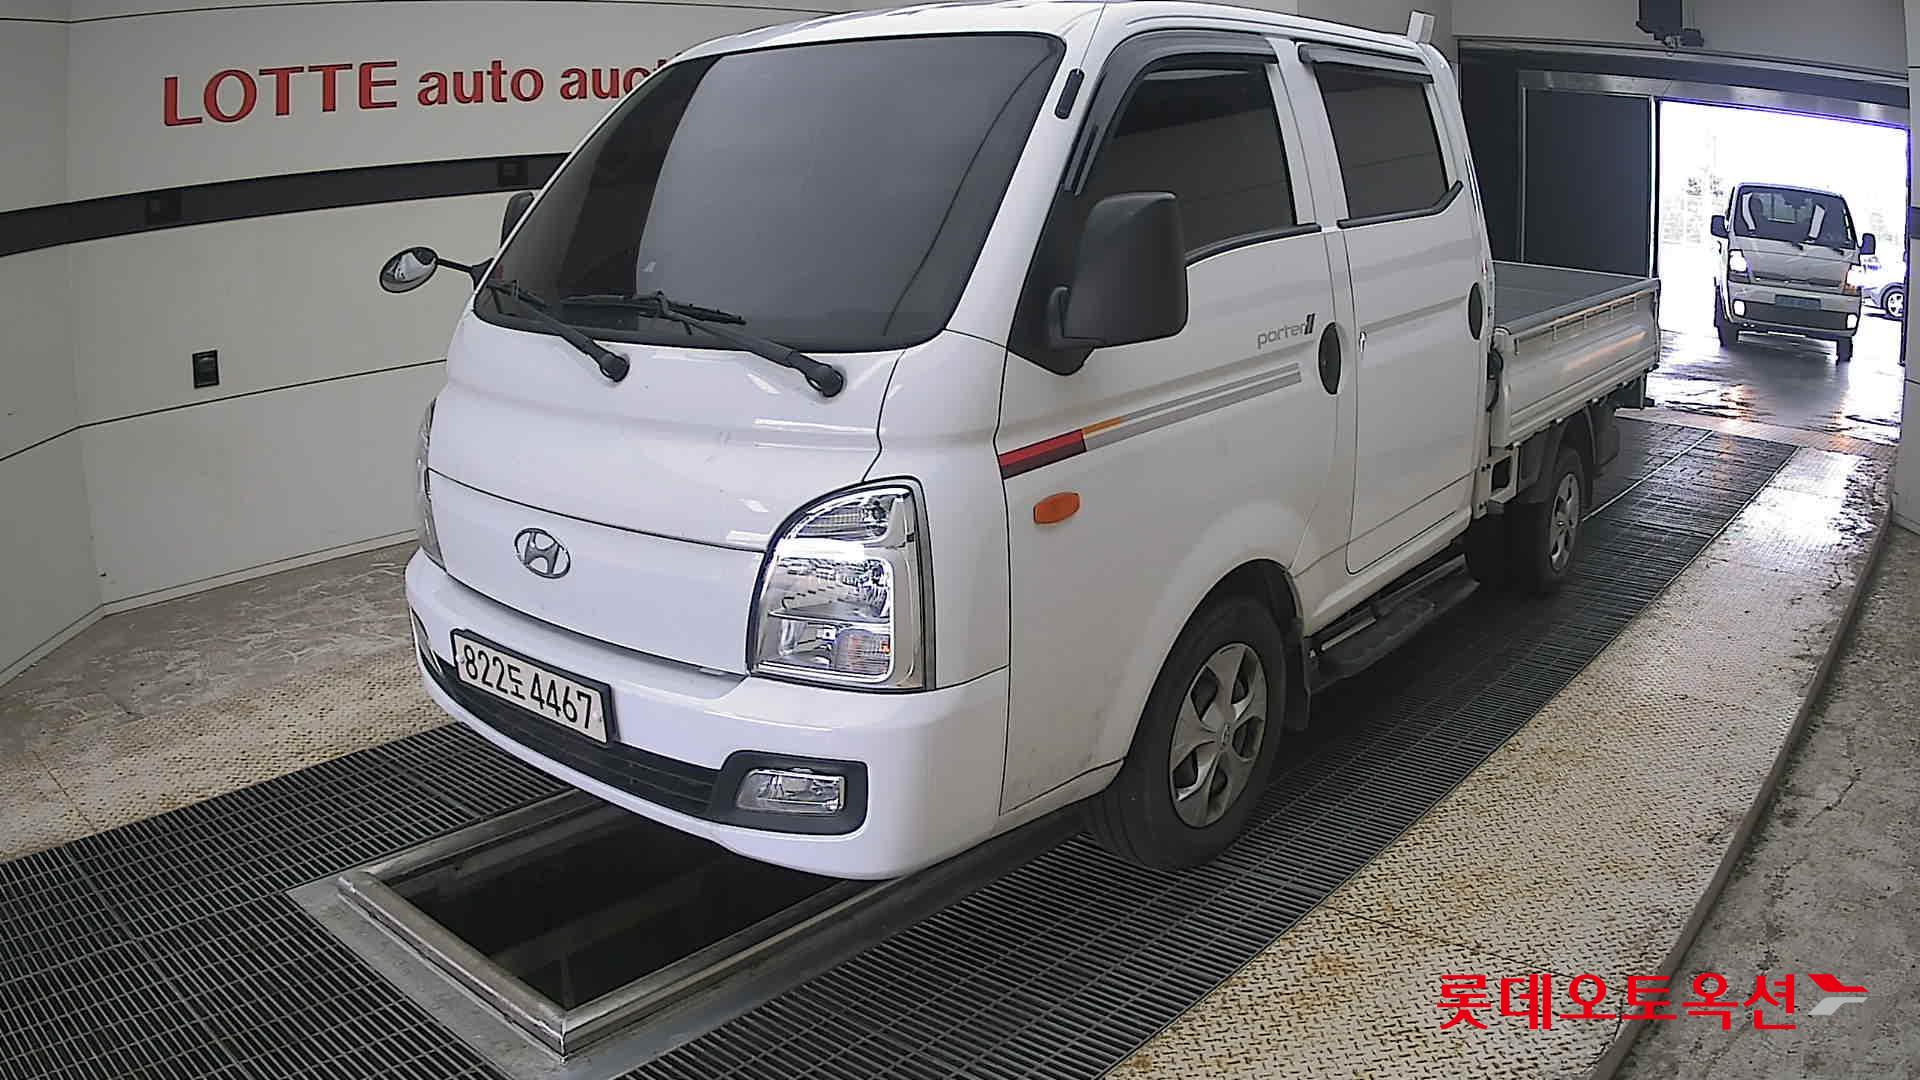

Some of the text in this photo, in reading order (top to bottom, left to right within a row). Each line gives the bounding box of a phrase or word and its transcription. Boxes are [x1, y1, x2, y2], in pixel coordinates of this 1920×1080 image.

[163, 59, 668, 127] LOTTE auto auc
